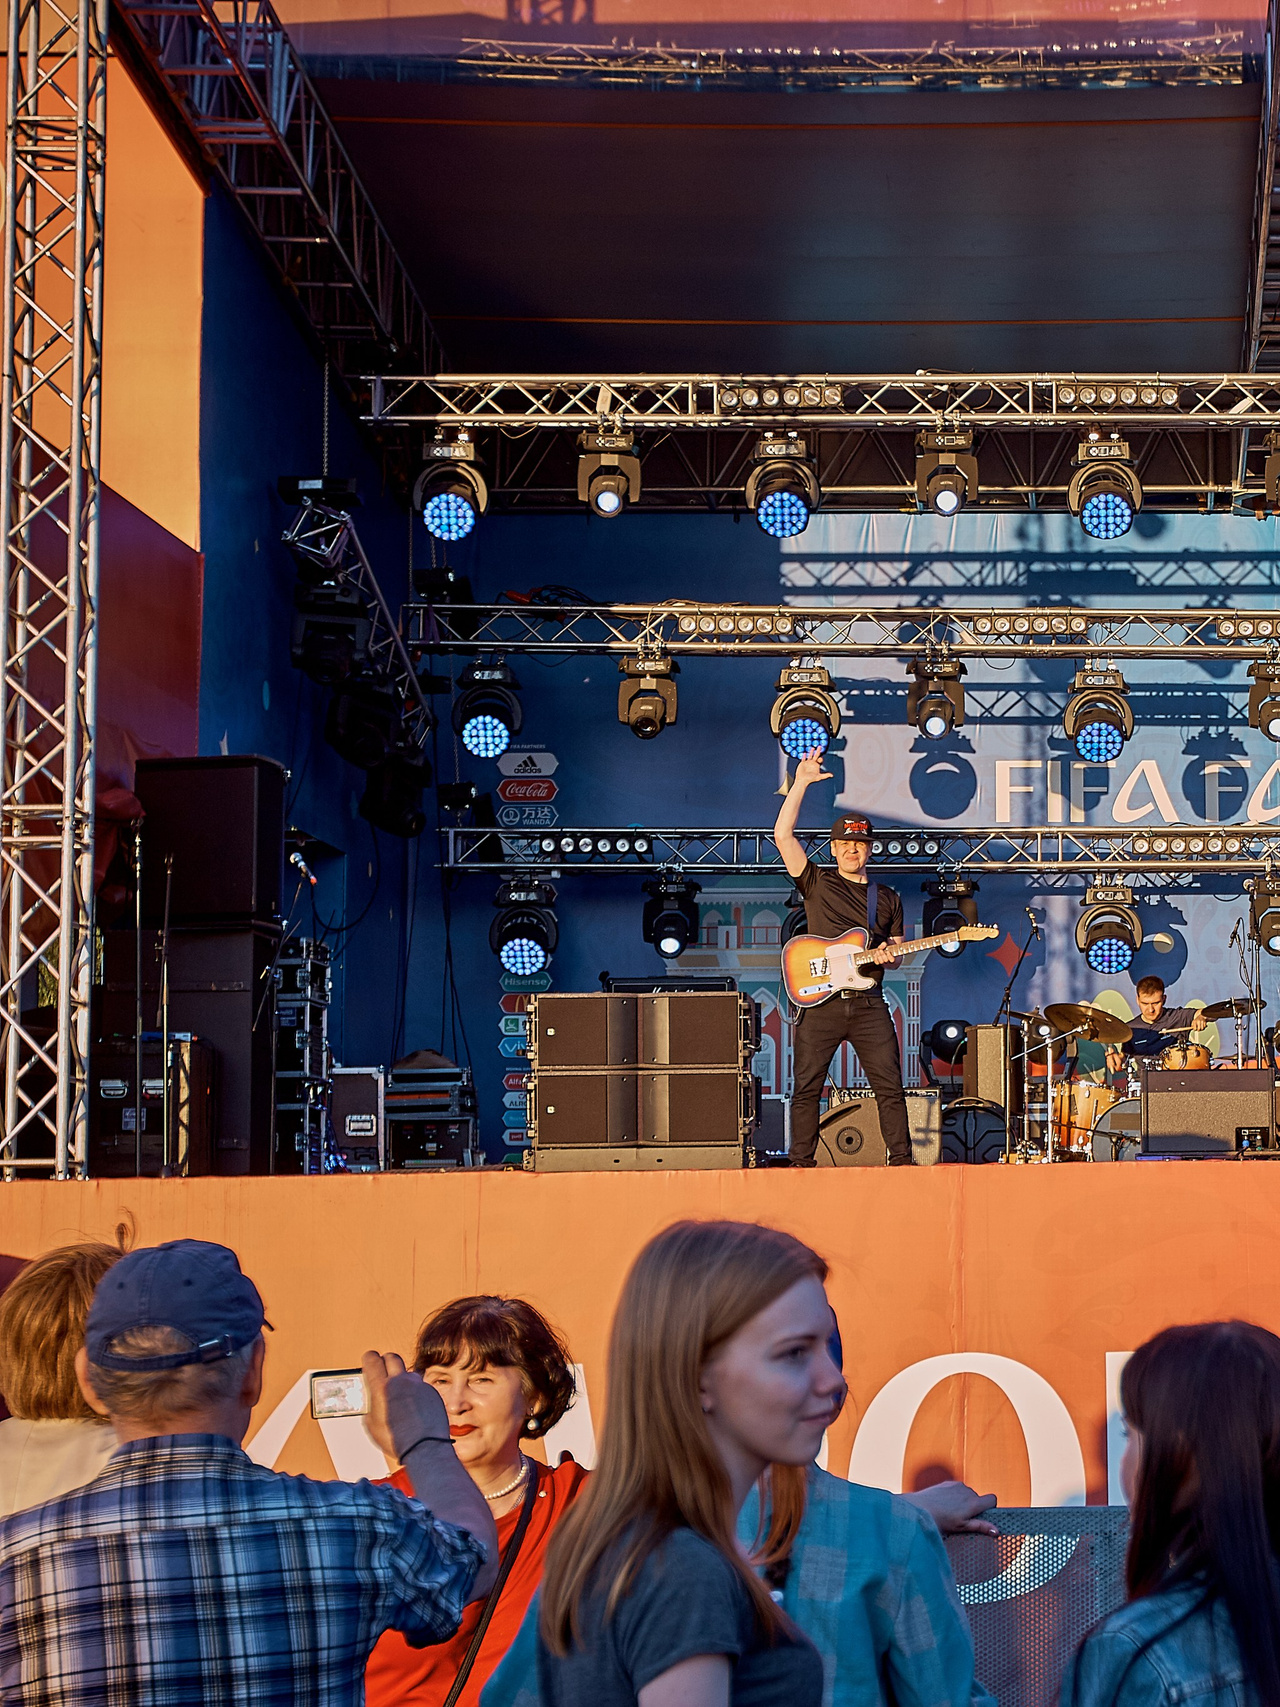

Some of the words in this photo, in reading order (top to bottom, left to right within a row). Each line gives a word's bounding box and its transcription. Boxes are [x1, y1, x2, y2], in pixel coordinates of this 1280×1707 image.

[994, 759, 1179, 823] FIFA
[522, 807, 551, 819] 万达
[504, 978, 547, 986] Hisense
